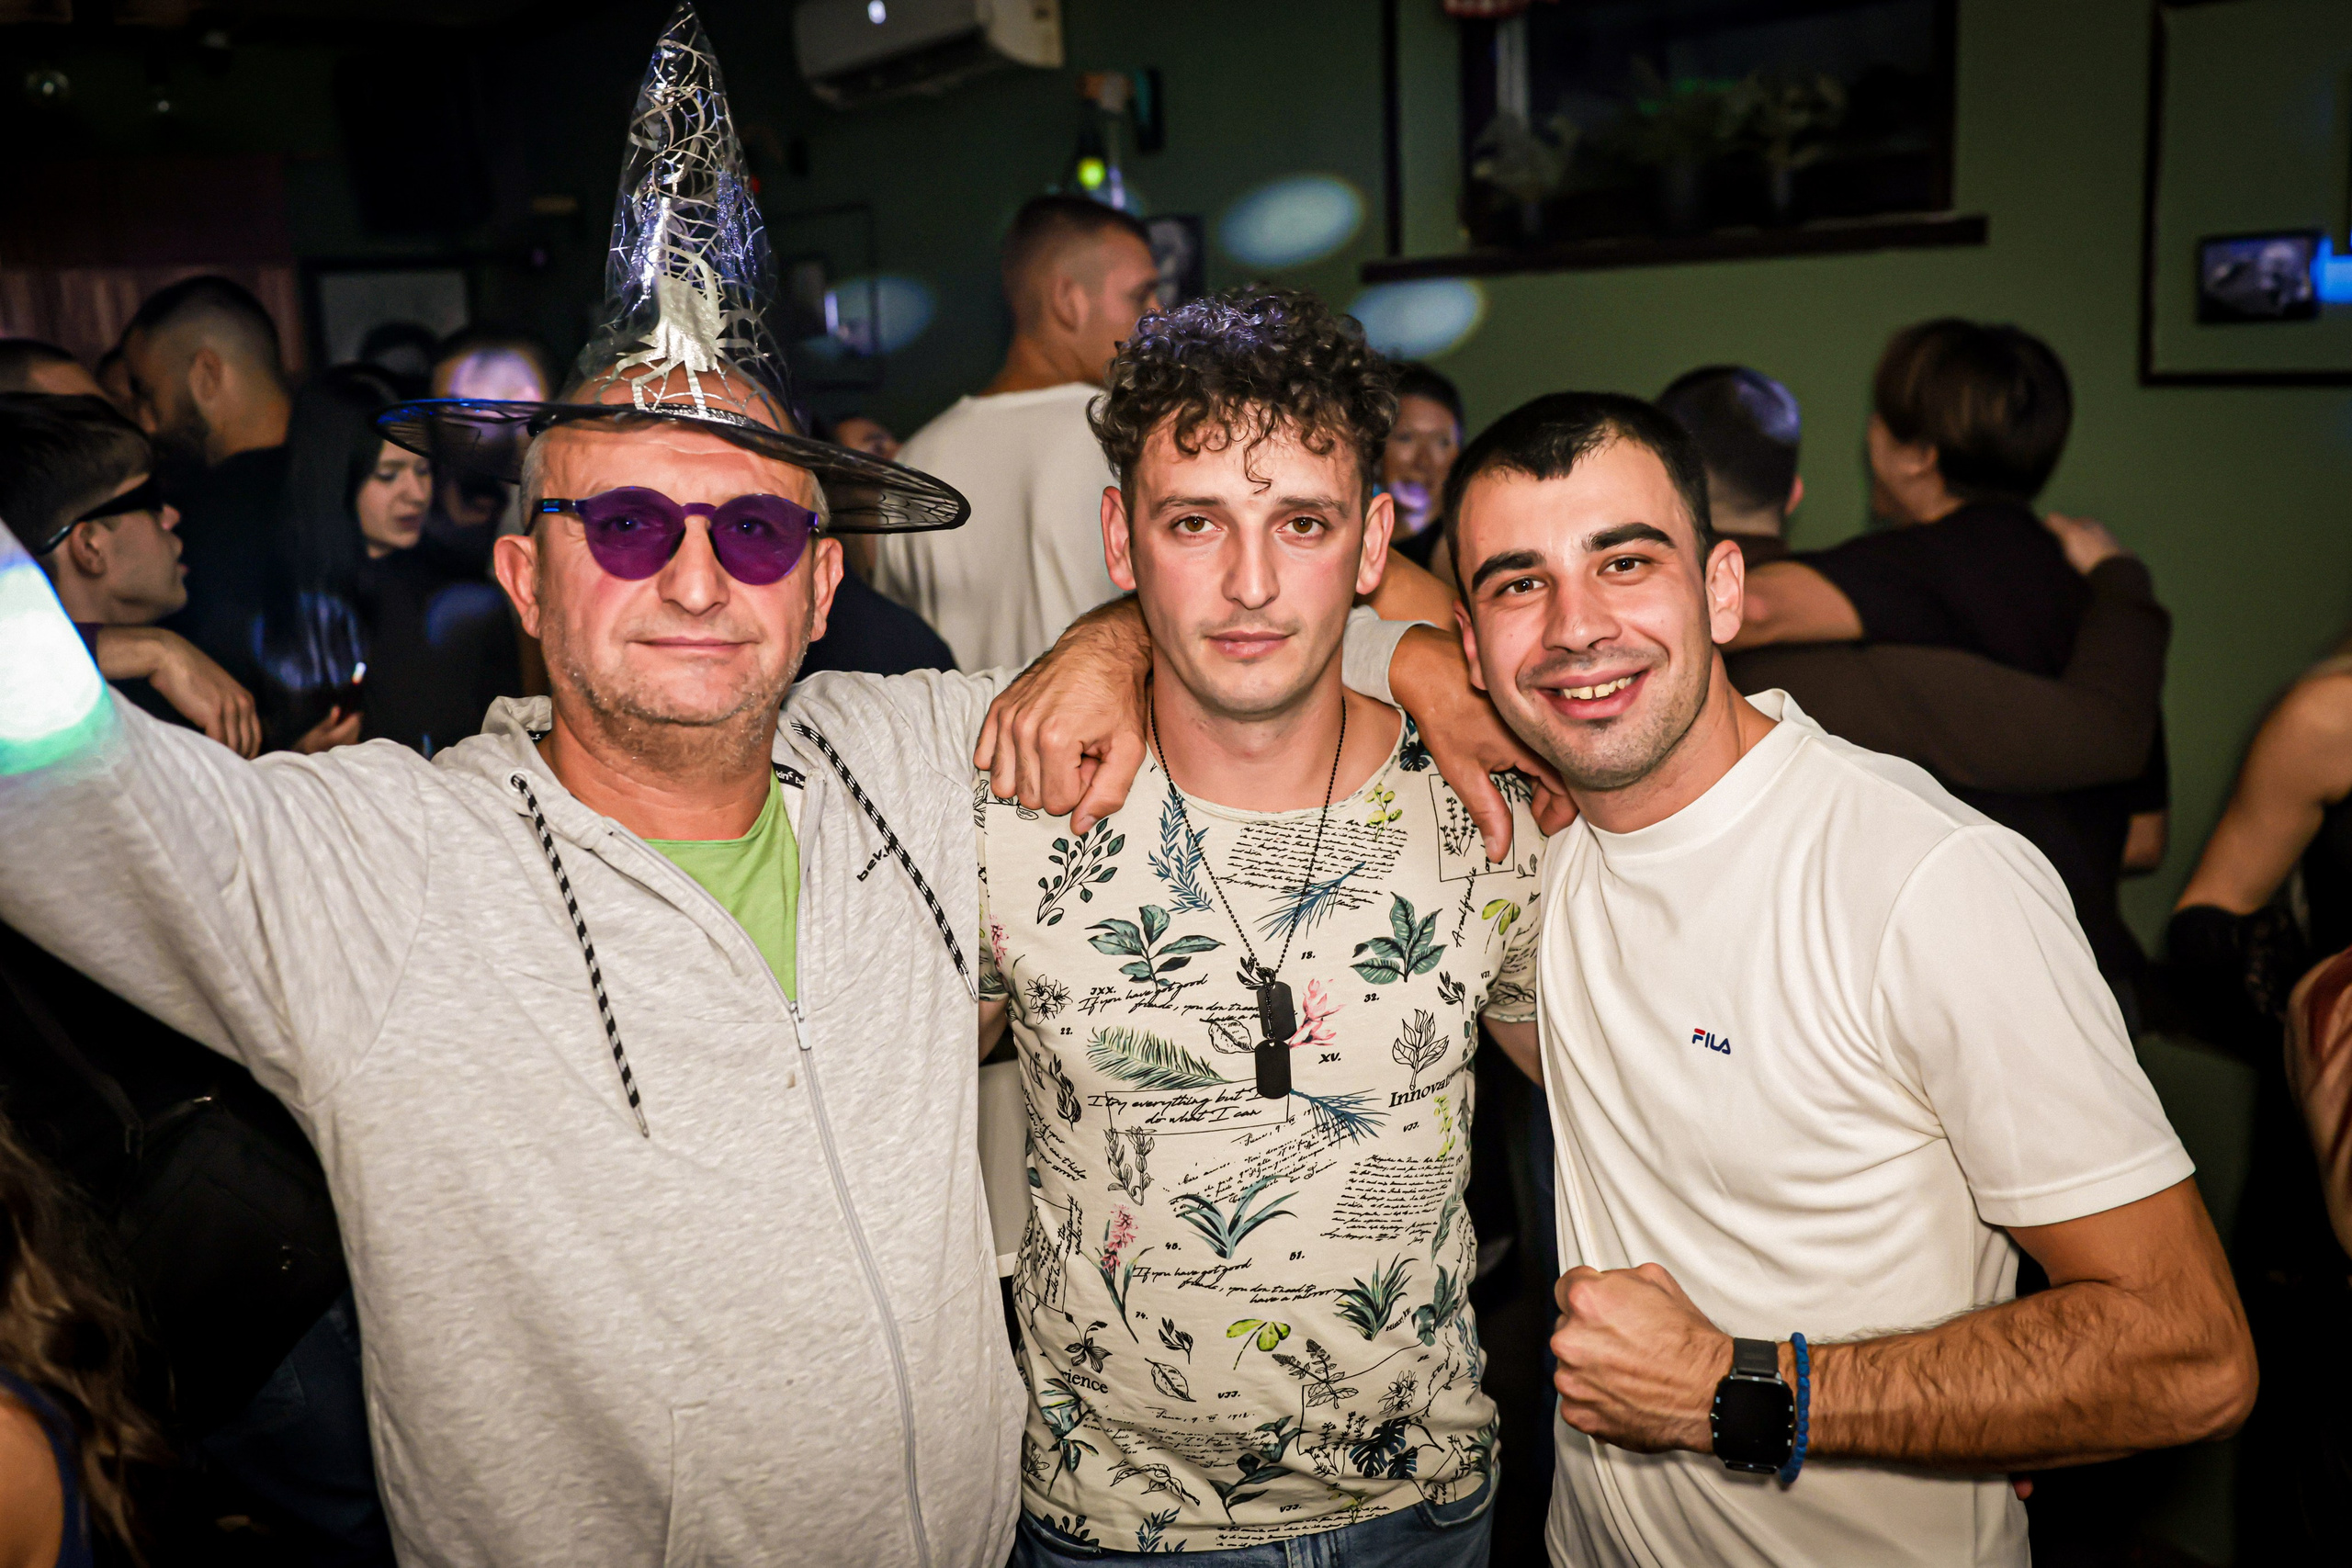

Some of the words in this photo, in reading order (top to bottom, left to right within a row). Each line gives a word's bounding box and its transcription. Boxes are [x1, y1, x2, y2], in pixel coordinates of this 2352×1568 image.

[1078, 996, 1100, 1016] If
[1100, 997, 1122, 1013] you
[1692, 1028, 1731, 1055] FILA
[1131, 1093, 1213, 1118] everything
[1215, 1089, 1247, 1103] but
[1145, 1111, 1167, 1123] do
[1169, 1110, 1212, 1123] what
[1133, 1266, 1152, 1283] If
[1152, 1271, 1171, 1283] you
[1174, 1268, 1200, 1277] have
